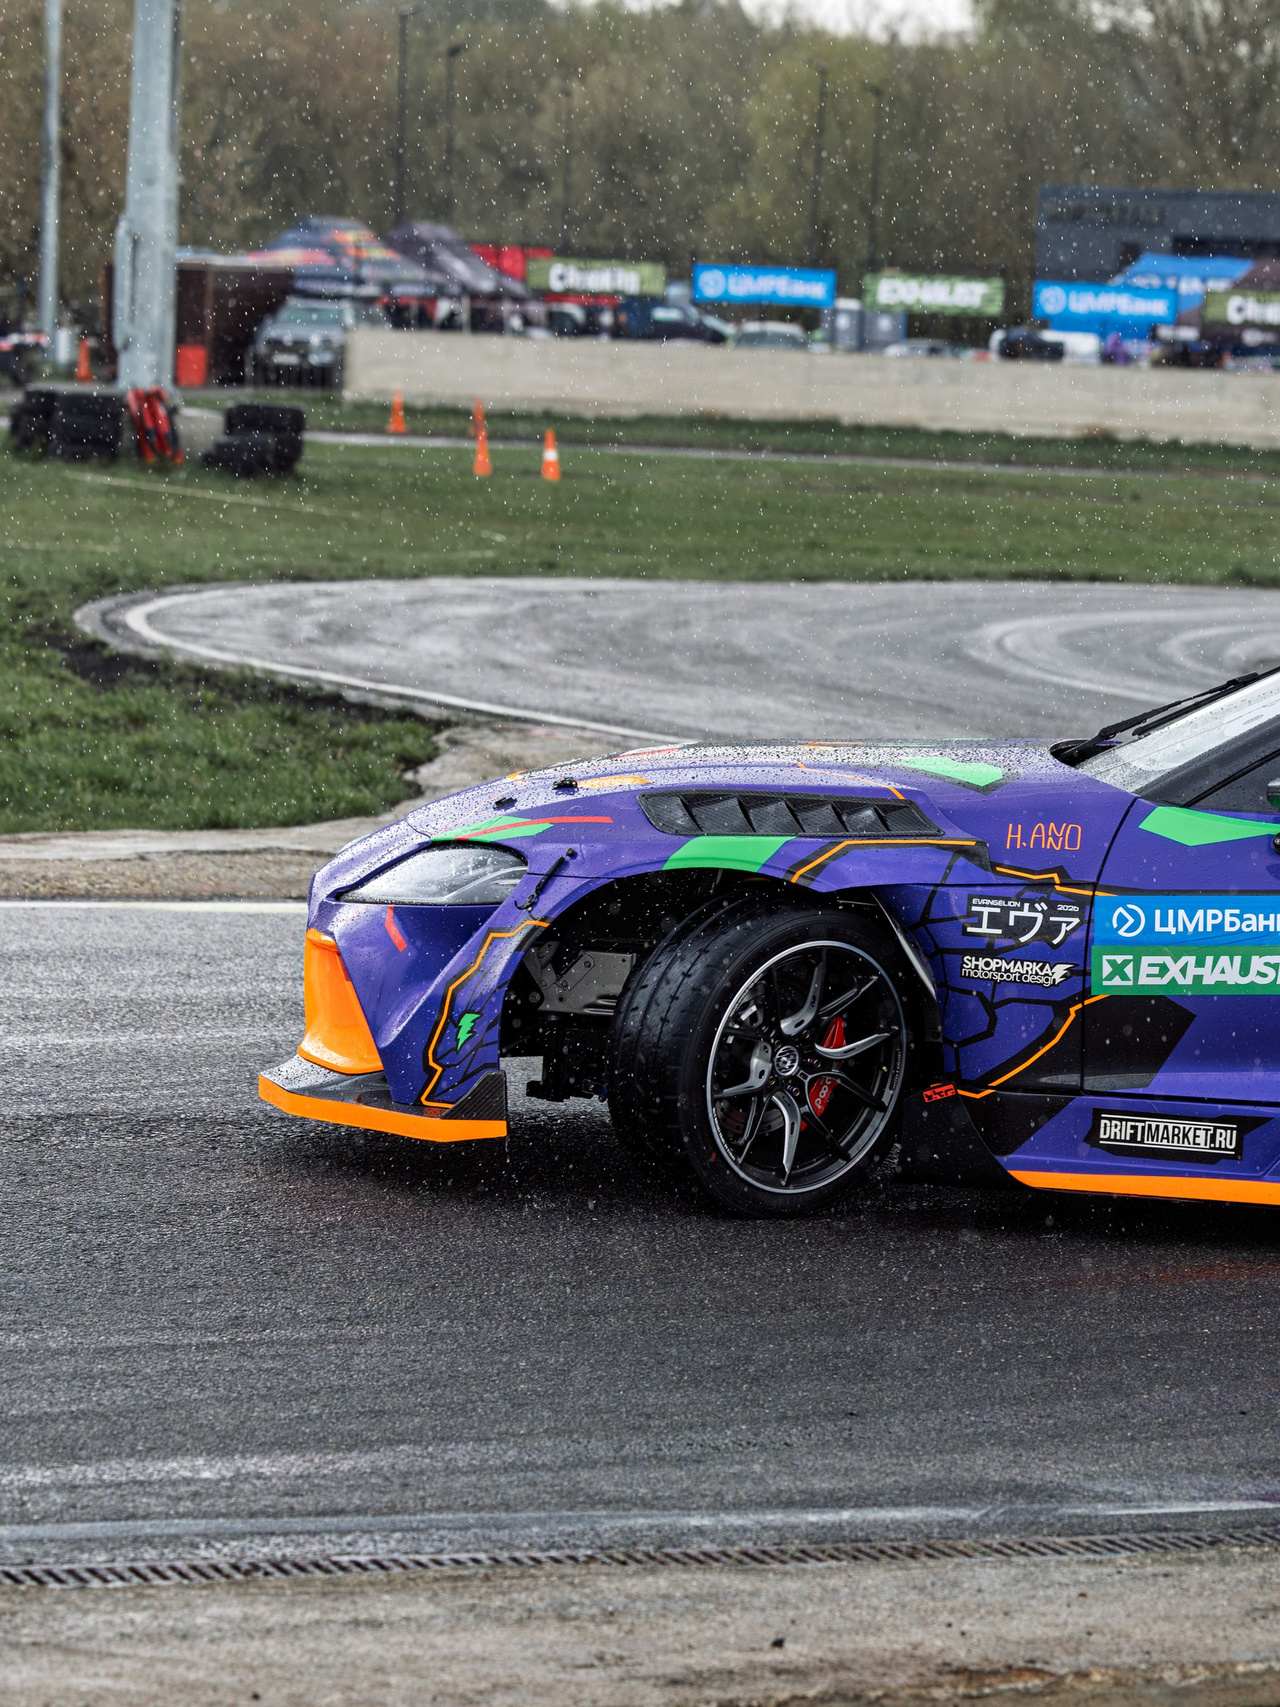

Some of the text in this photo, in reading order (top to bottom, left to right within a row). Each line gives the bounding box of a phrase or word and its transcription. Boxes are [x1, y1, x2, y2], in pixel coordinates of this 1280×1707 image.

[972, 898, 1021, 908] EVANGELION
[966, 902, 1080, 945] エヴァ
[963, 955, 1053, 976] SHOPMARKA
[961, 967, 1058, 987] motorsport design
[1100, 1119, 1238, 1149] DRIFTMARKET.RU
